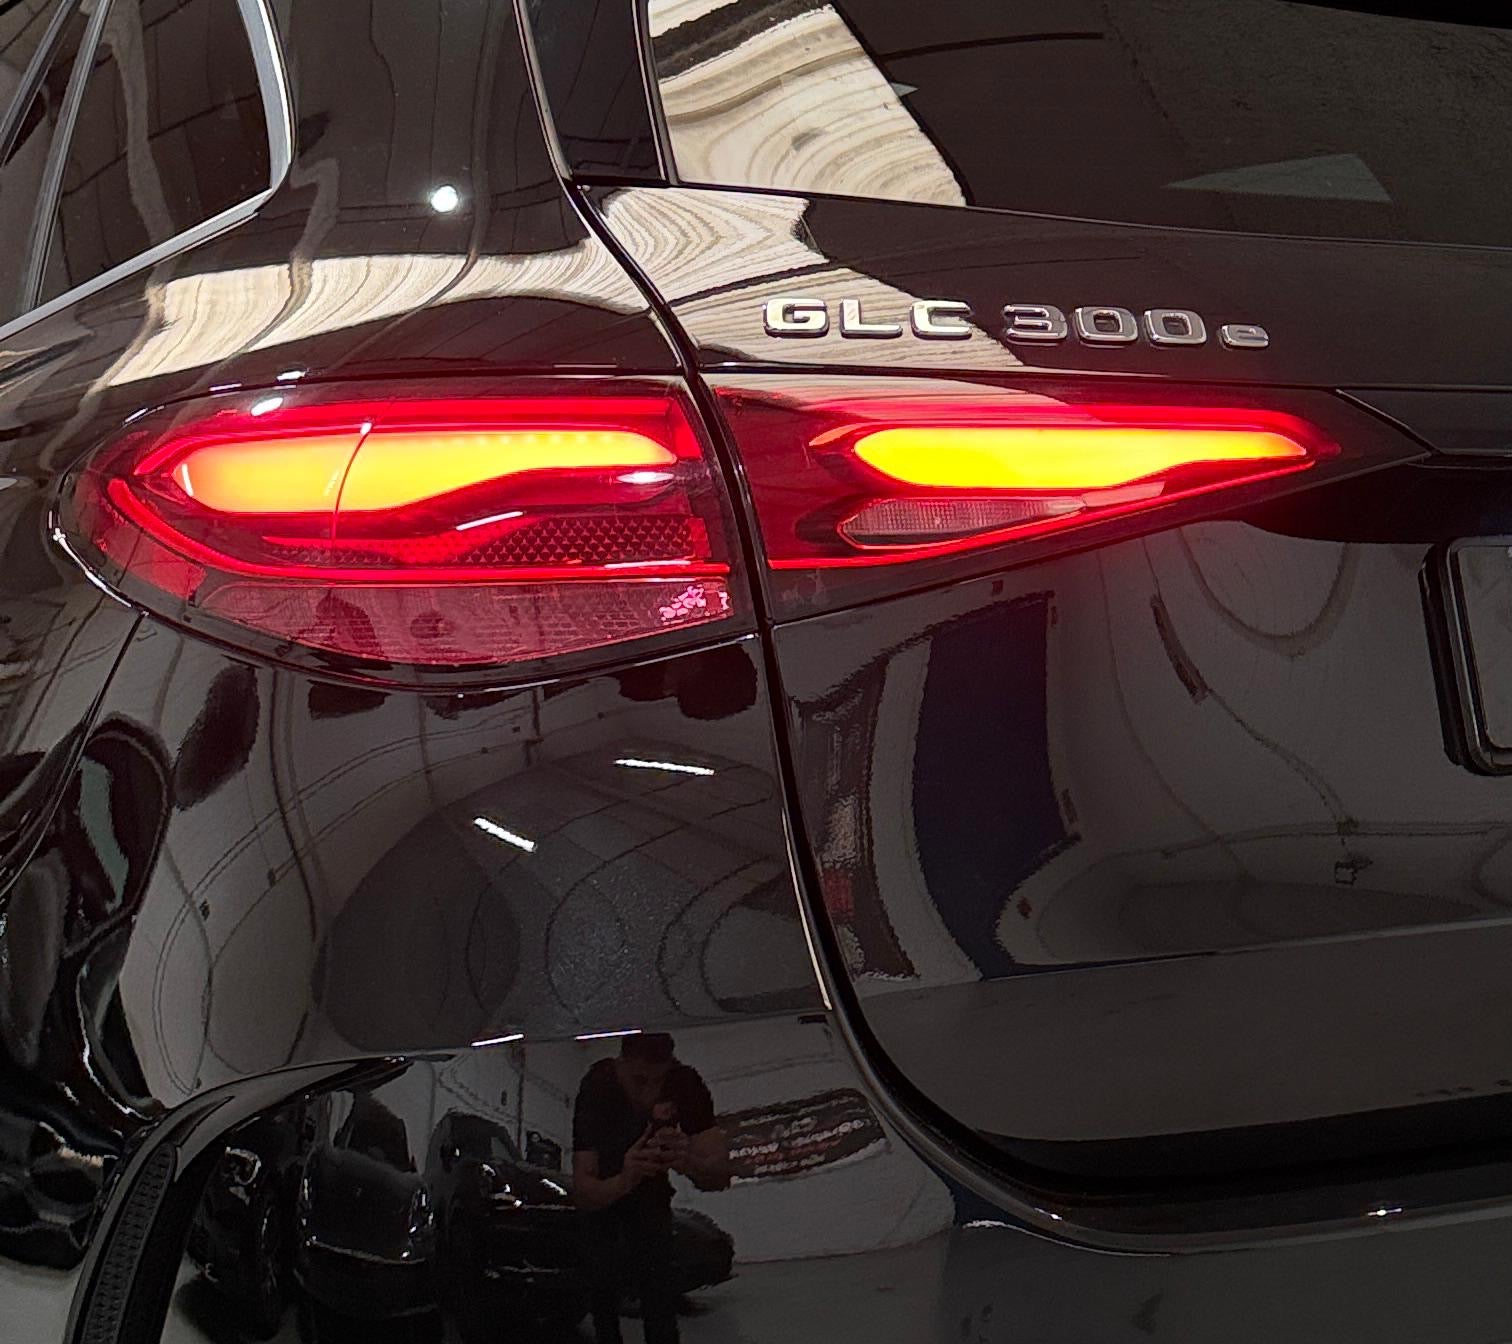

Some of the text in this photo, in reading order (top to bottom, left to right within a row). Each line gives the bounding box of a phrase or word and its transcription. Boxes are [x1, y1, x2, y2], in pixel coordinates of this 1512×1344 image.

[763, 298, 1270, 350] GLC 300 e
